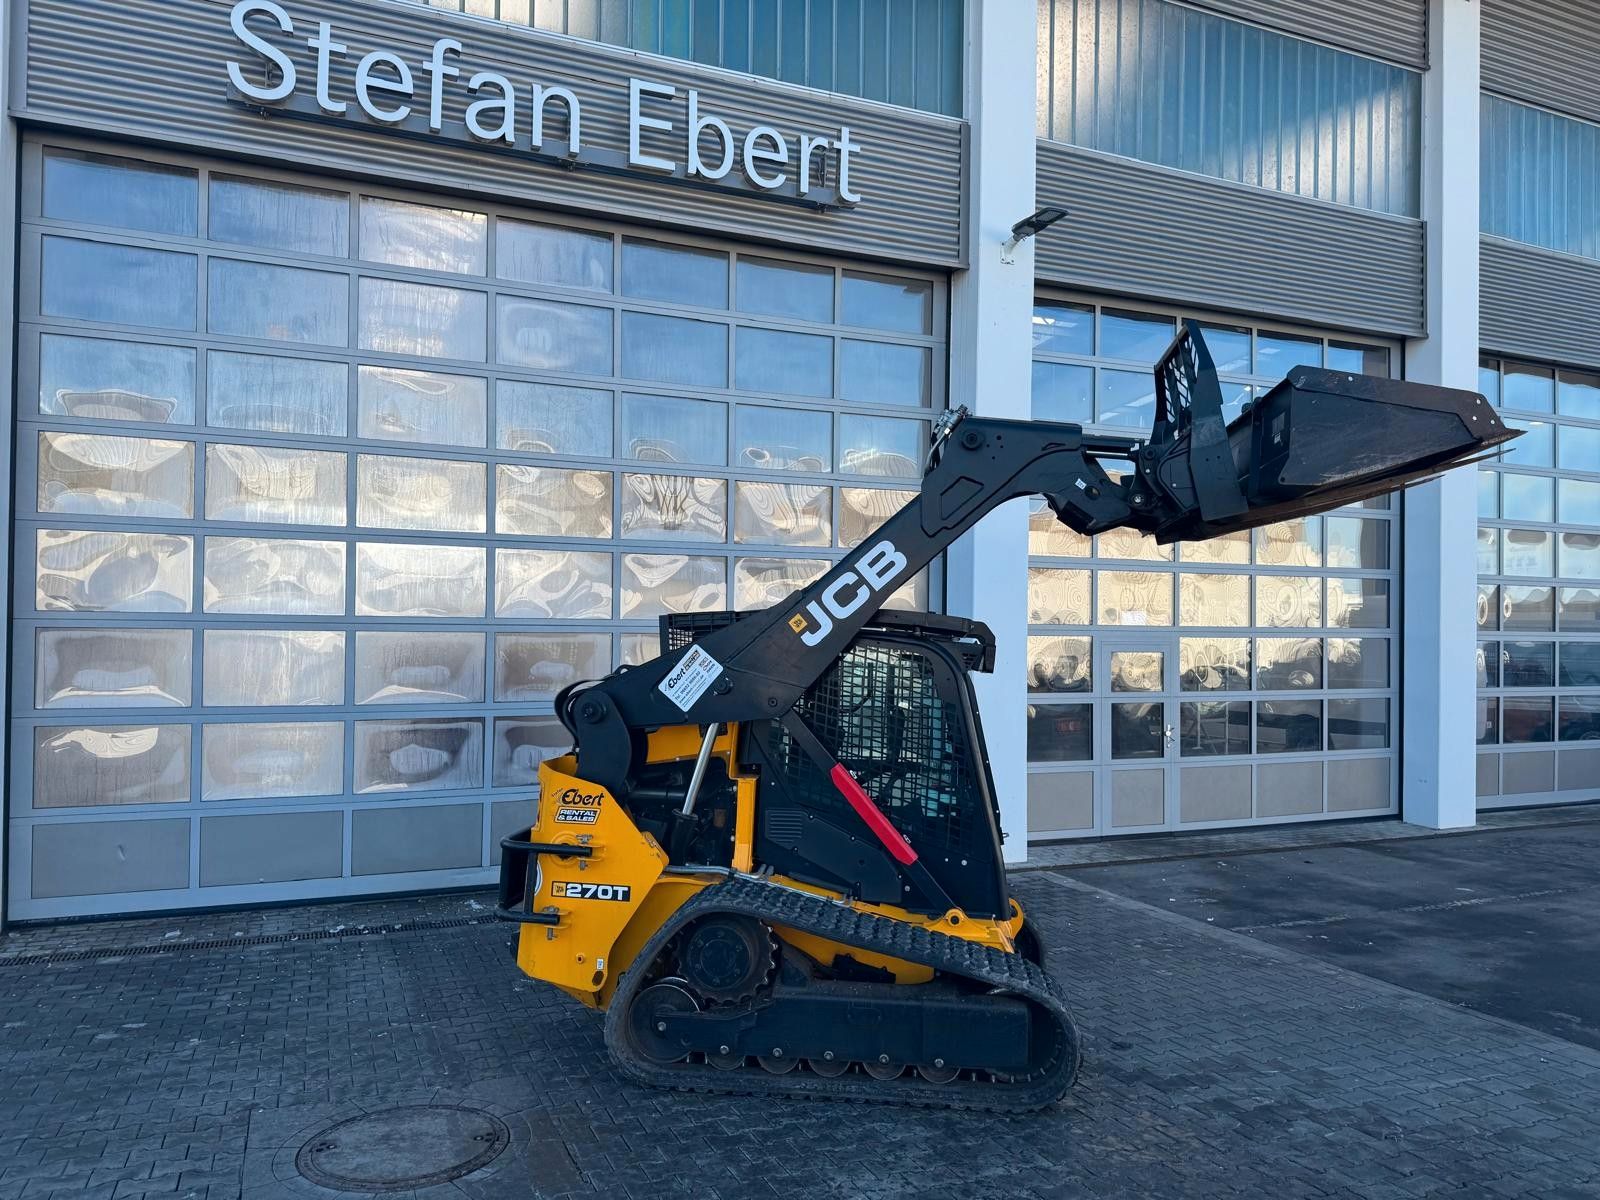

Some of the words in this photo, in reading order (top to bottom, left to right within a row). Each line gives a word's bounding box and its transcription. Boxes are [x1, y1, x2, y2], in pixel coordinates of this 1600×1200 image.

[226, 0, 581, 155] Stefan
[629, 77, 861, 203] Ebert
[800, 540, 908, 647] JCB
[562, 788, 604, 806] Ebert
[567, 884, 628, 901] 270T
